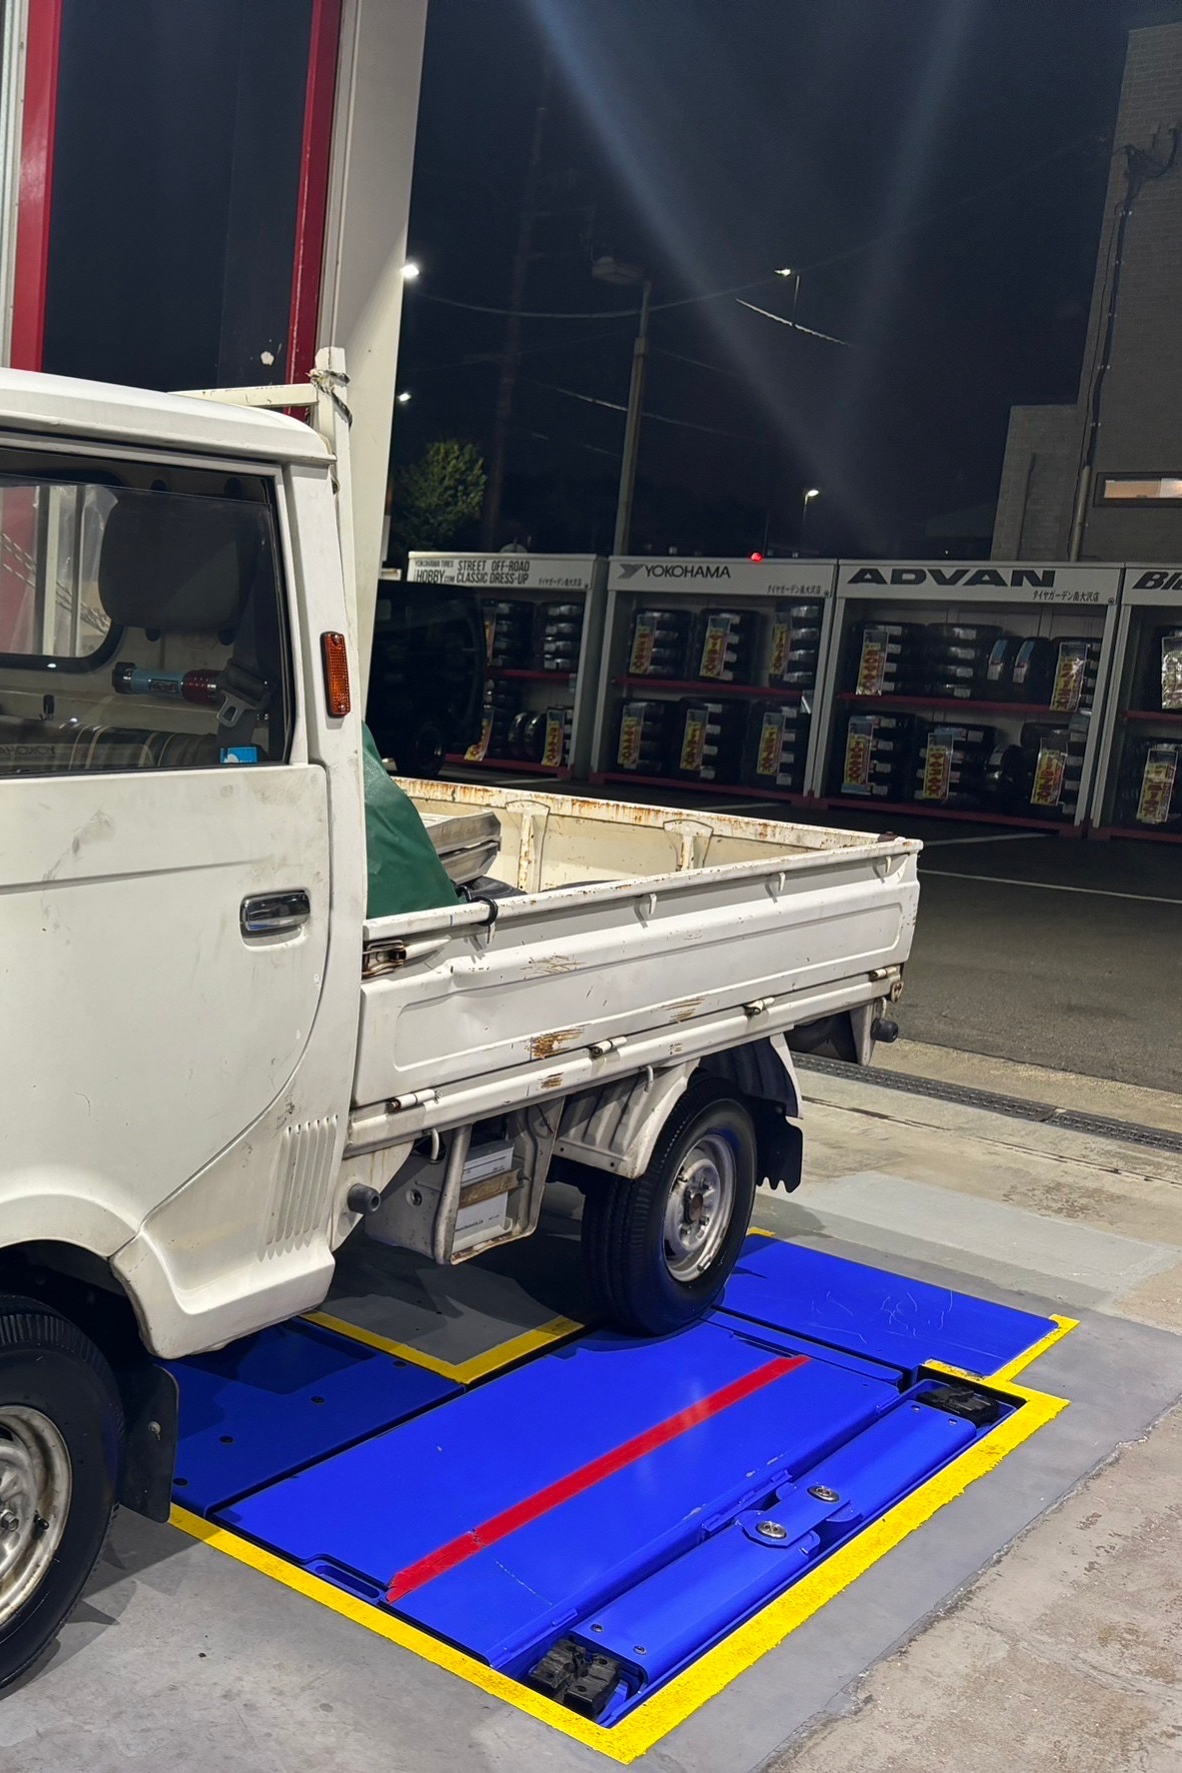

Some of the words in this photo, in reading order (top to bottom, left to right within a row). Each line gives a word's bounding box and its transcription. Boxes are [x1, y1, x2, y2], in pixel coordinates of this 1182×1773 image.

[458, 560, 486, 571] STREET
[491, 560, 530, 572] OFF-ROAD
[644, 564, 731, 579] YOKOHAMA
[457, 572, 488, 584] CLASSIC
[489, 573, 529, 584] DRESS-UP
[847, 568, 1056, 588] ADVAN
